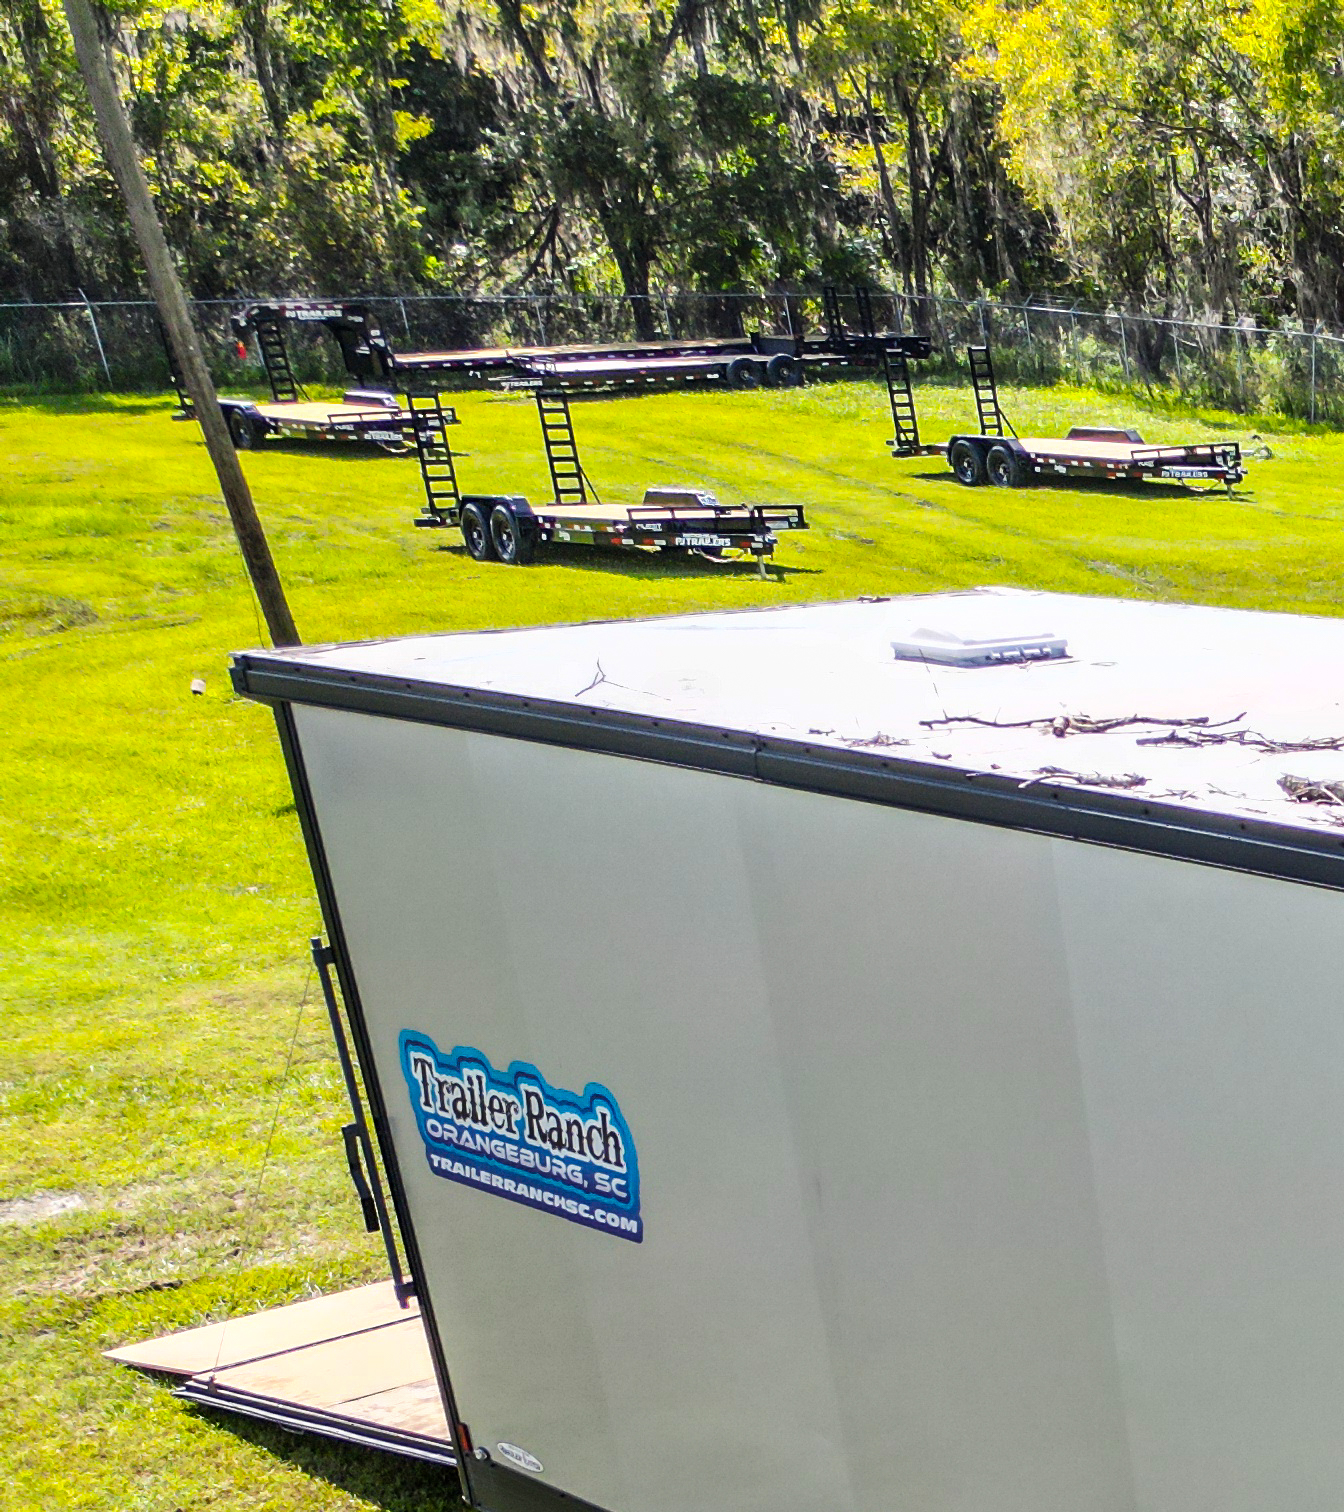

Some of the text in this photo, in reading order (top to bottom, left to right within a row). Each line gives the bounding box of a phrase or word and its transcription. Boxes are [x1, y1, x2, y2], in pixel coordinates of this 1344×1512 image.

[685, 536, 731, 547] TRAILERS
[411, 1055, 626, 1169] Trailer Ranch
[426, 1118, 628, 1198] ORANGEBURG, SC
[430, 1153, 638, 1234] TRAILERRANCHSC.COM
